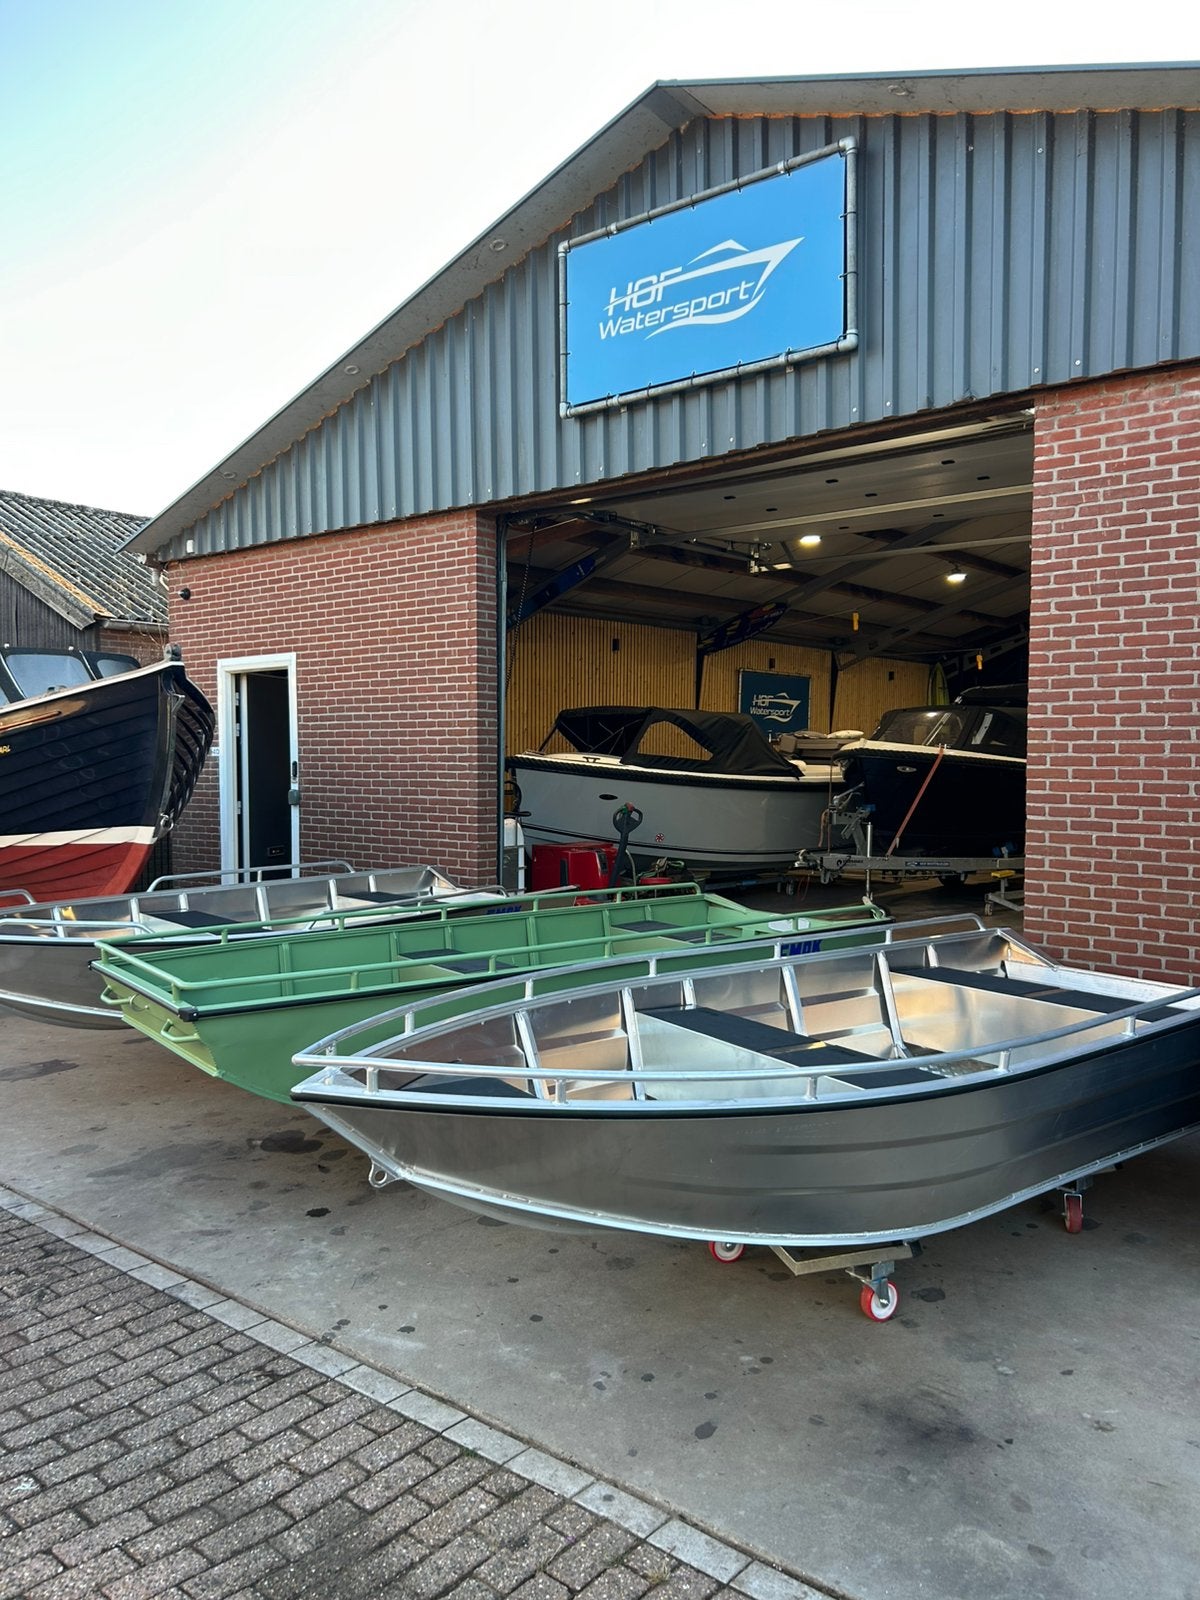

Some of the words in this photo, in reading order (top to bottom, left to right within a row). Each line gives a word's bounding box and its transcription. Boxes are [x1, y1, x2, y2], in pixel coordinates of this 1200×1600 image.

[604, 266, 683, 316] HOF
[599, 280, 755, 340] Watersport
[749, 706, 791, 717] Watersport
[752, 694, 774, 706] HOF
